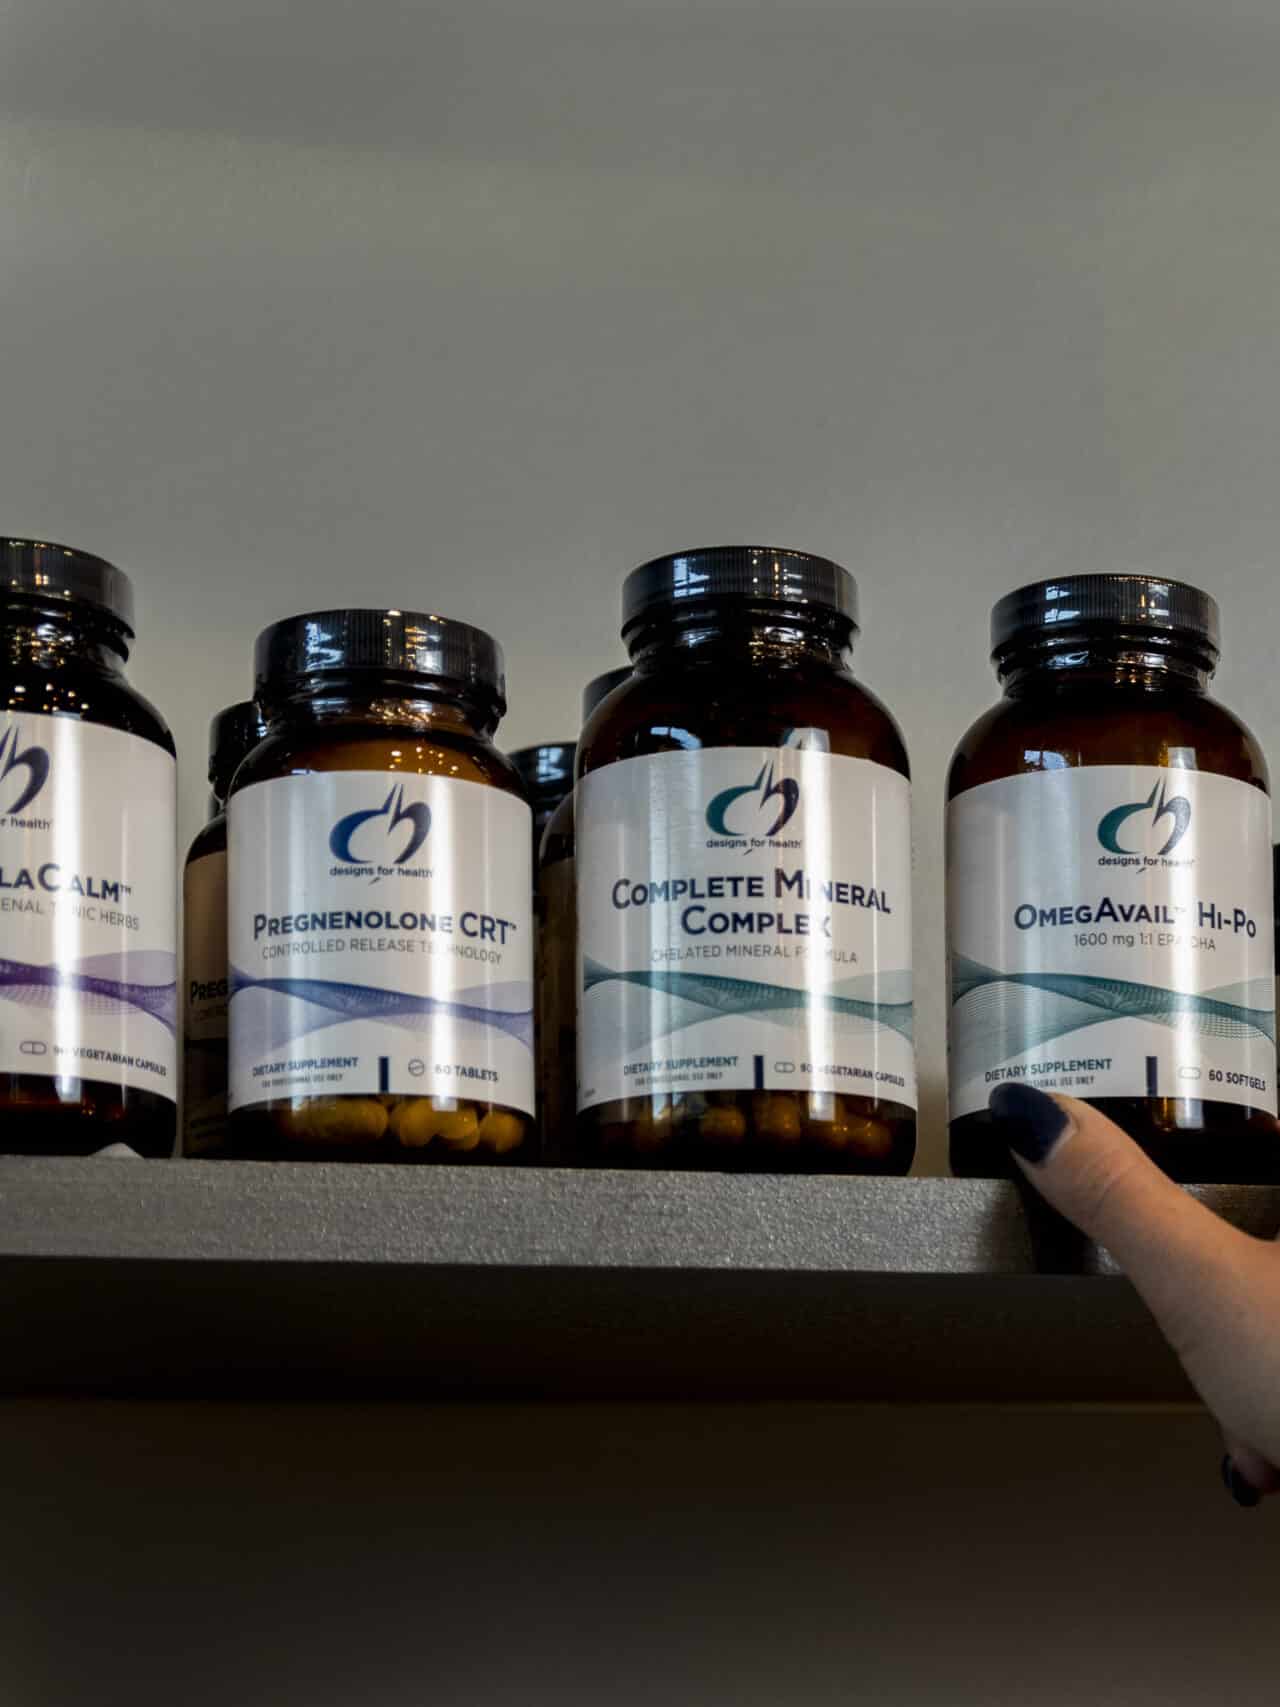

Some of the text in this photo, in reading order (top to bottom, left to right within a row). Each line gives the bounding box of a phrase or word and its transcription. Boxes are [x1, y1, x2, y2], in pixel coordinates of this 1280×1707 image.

[10, 816, 50, 830] health
[706, 838, 747, 849] designs
[750, 838, 766, 848] for
[1098, 856, 1140, 867] designs
[1143, 856, 1158, 866] for
[329, 865, 374, 877] designs
[377, 865, 393, 876] for
[612, 876, 764, 909] COMPLETE
[99, 908, 141, 931] HERBS
[253, 910, 454, 941] PREGNENOLONE
[1074, 933, 1107, 948] 1600
[1112, 934, 1134, 948] mg
[1140, 932, 1153, 945] 1:1
[262, 939, 345, 961] CONTROLLED
[350, 938, 415, 953] RELEASE
[650, 945, 721, 962] CHELATED
[726, 944, 793, 959] MINERAL
[287, 1057, 359, 1071] SUPPLEMENT
[623, 1056, 738, 1075] DIETARY SUPPLEMENT
[984, 1058, 1113, 1083] DIETARY SUPPLEMENT
[454, 1065, 498, 1082] TABLETS
[1208, 1069, 1223, 1082] 60
